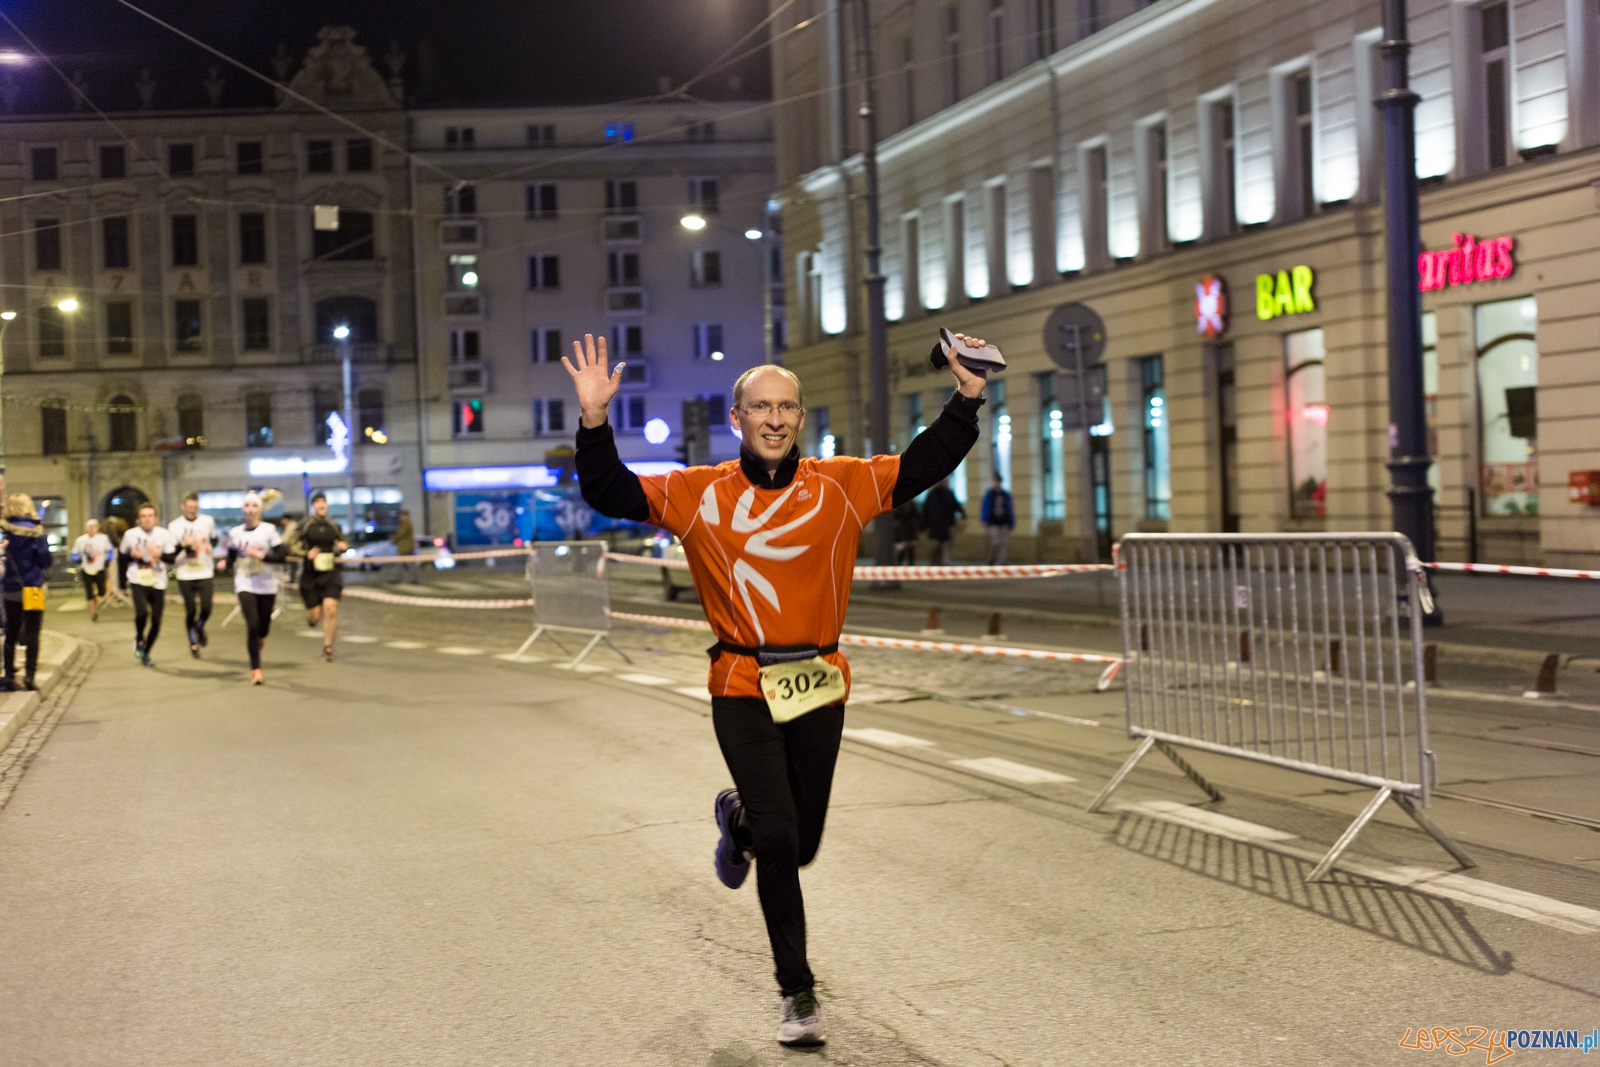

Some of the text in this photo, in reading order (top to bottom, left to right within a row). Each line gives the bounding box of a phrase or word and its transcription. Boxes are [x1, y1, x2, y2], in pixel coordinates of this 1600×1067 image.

[1418, 232, 1513, 292] aritas
[1256, 265, 1315, 320] BAR
[777, 670, 829, 700] 302
